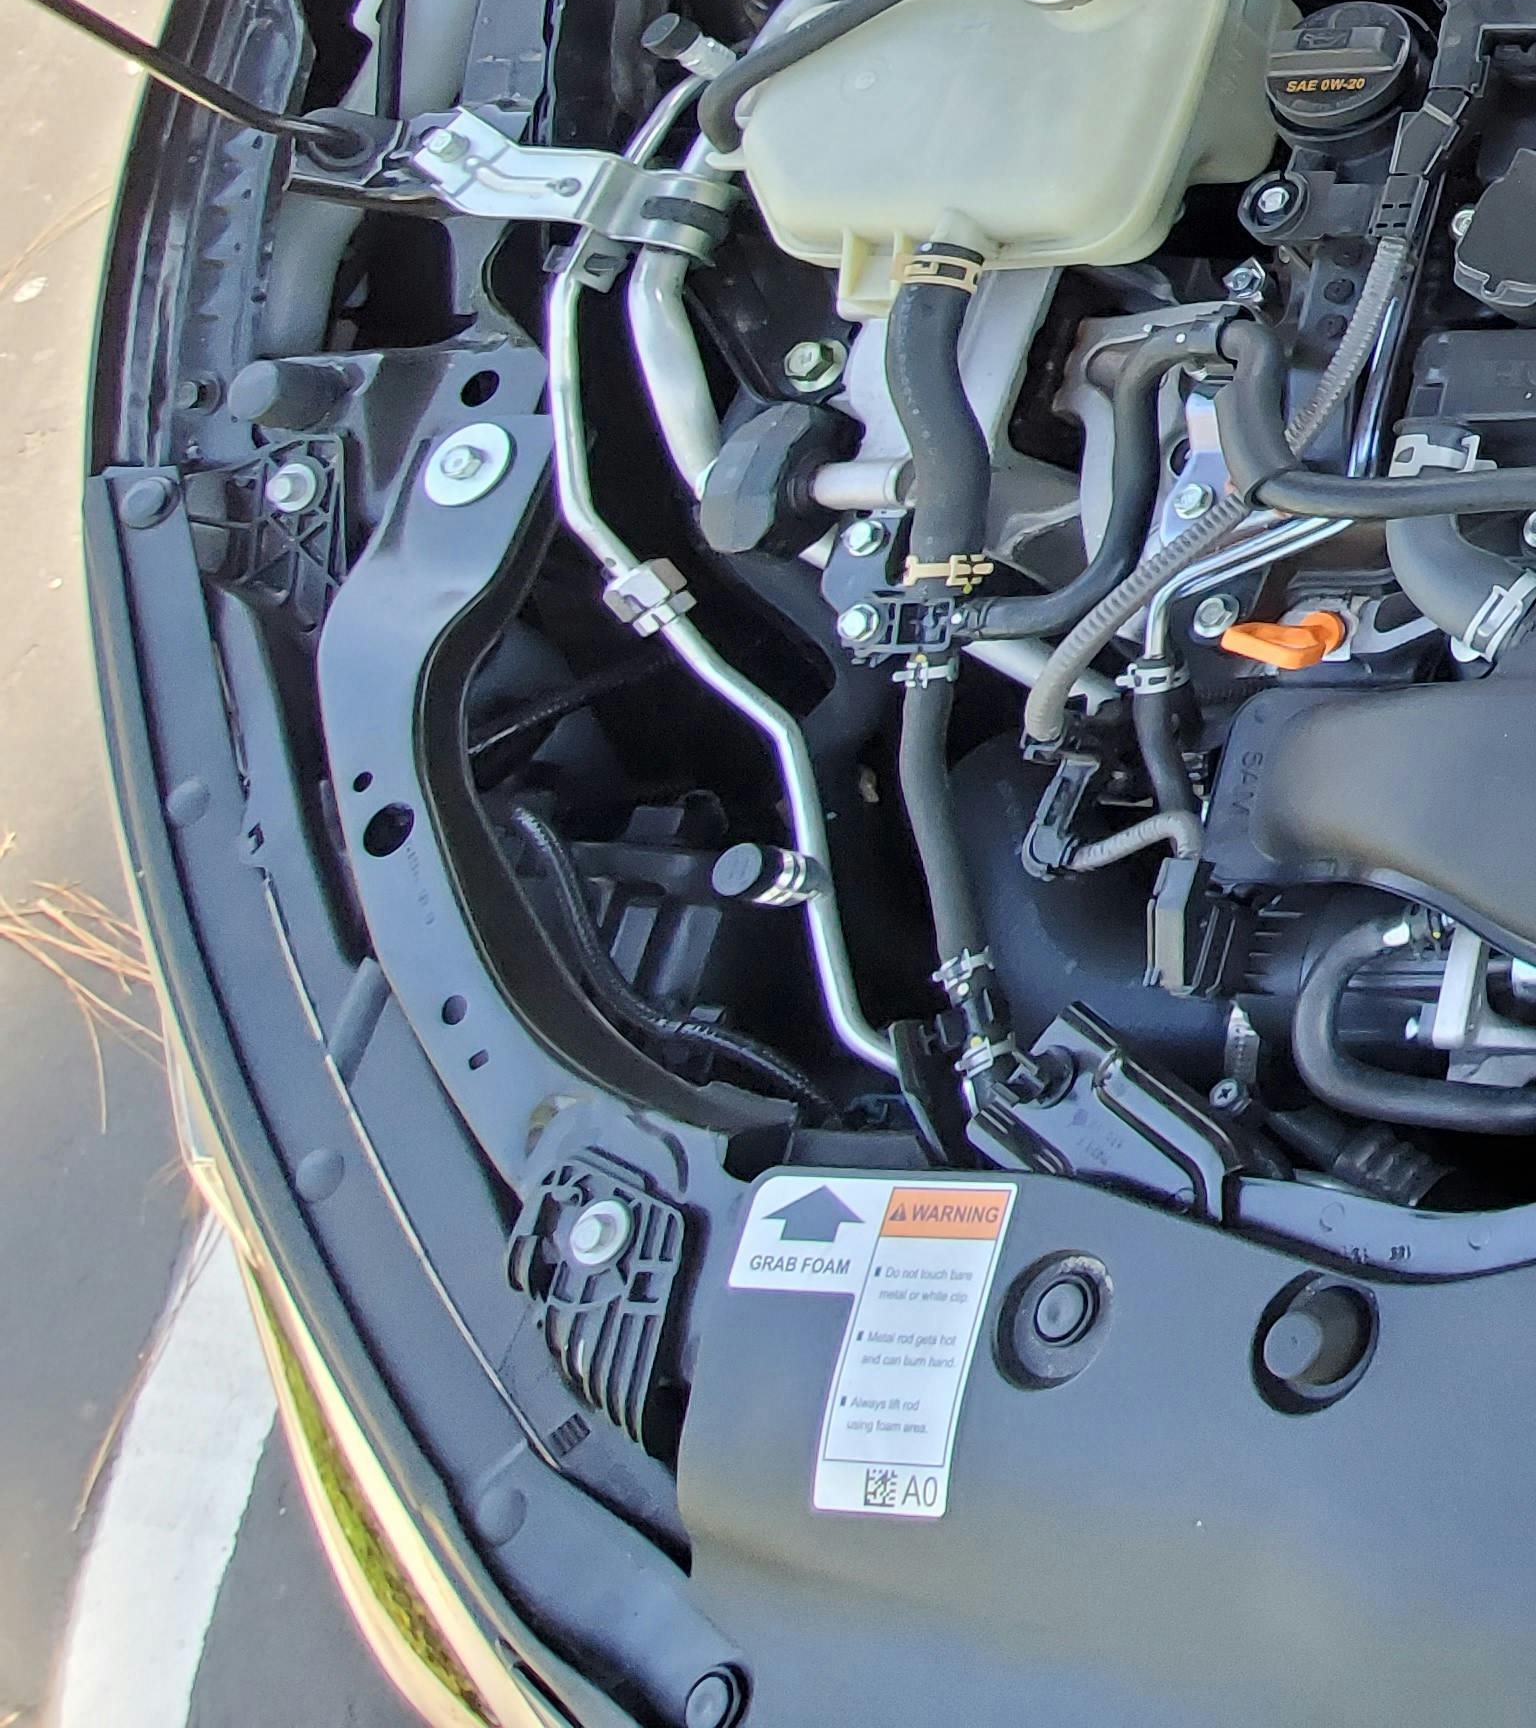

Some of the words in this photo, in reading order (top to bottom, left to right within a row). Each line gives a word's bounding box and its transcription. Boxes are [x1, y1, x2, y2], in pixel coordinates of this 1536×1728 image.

[1286, 80, 1319, 93] SAE
[1320, 78, 1366, 91] 0W-20
[911, 1203, 1000, 1224] WARNING
[749, 1254, 797, 1273] GRAB
[801, 1257, 851, 1275] FOAM
[885, 1266, 899, 1279] Do
[901, 1267, 917, 1279] not
[920, 1267, 948, 1280] touch
[866, 1331, 895, 1344] Metal
[897, 1332, 914, 1345] rod
[939, 1333, 957, 1346] hot
[861, 1353, 881, 1365] and
[850, 1396, 886, 1411] Always
[902, 1399, 921, 1411] rod
